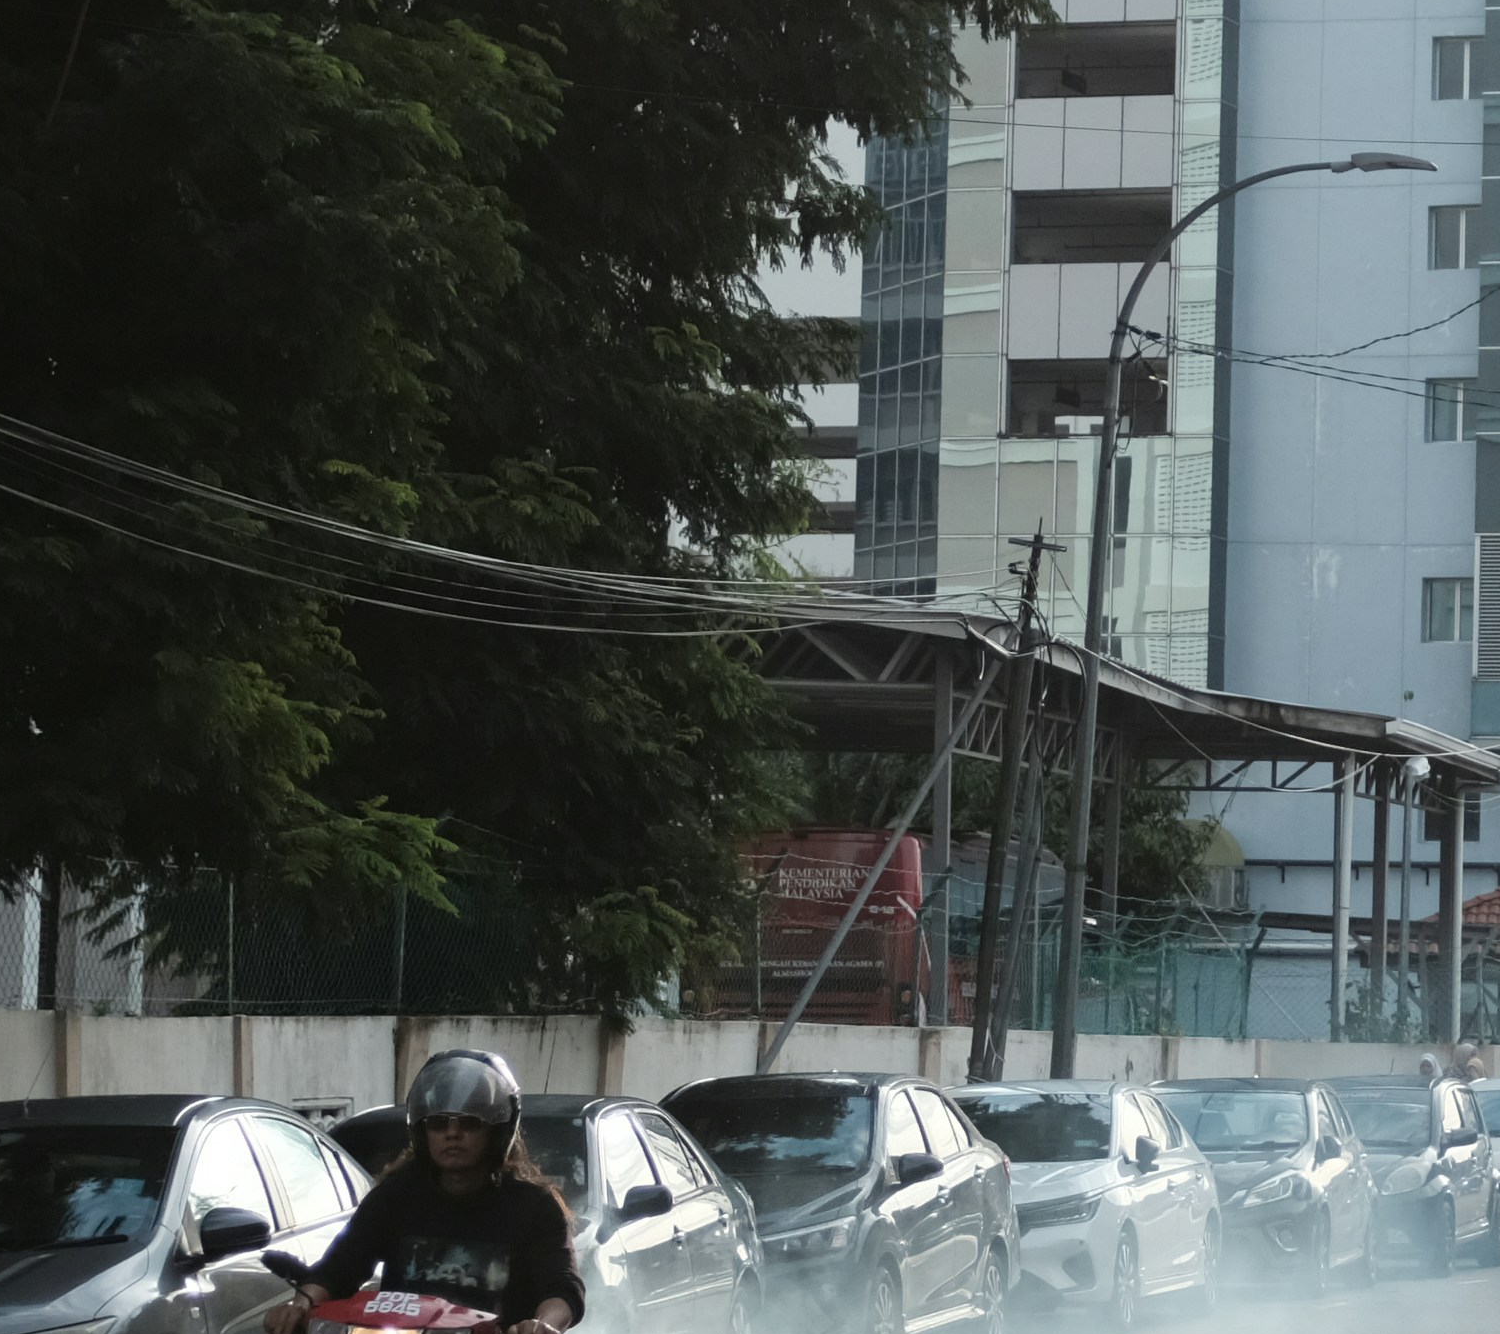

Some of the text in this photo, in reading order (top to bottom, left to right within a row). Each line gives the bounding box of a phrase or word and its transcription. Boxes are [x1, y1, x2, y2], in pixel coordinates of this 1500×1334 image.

[779, 866, 872, 879] KEMENTERIAN
[779, 878, 857, 889] PENDIDIKAN
[374, 1291, 420, 1304] PDP
